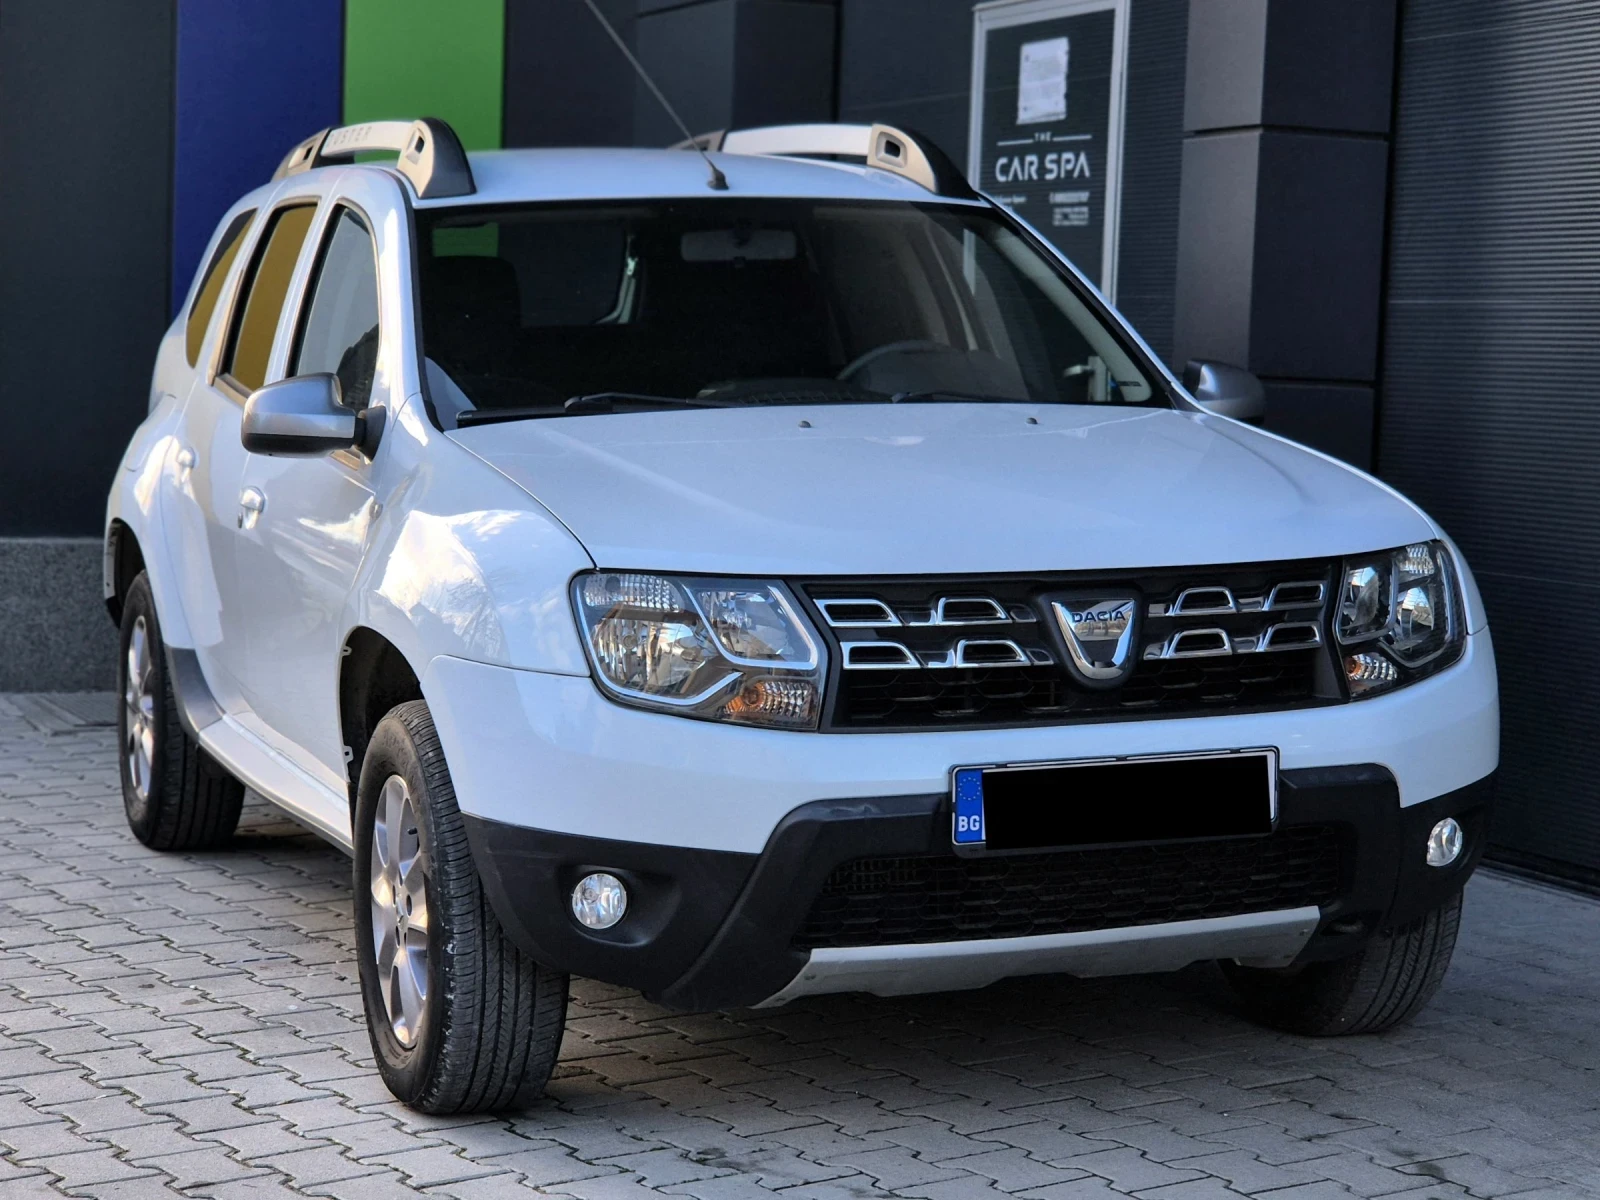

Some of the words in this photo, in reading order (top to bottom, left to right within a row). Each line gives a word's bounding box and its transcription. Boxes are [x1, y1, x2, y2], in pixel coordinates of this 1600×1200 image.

[1034, 132, 1052, 142] THE
[995, 154, 1039, 182] CAR
[1044, 151, 1090, 180] SPA
[1072, 611, 1126, 622] DACIA
[958, 815, 980, 832] BG
